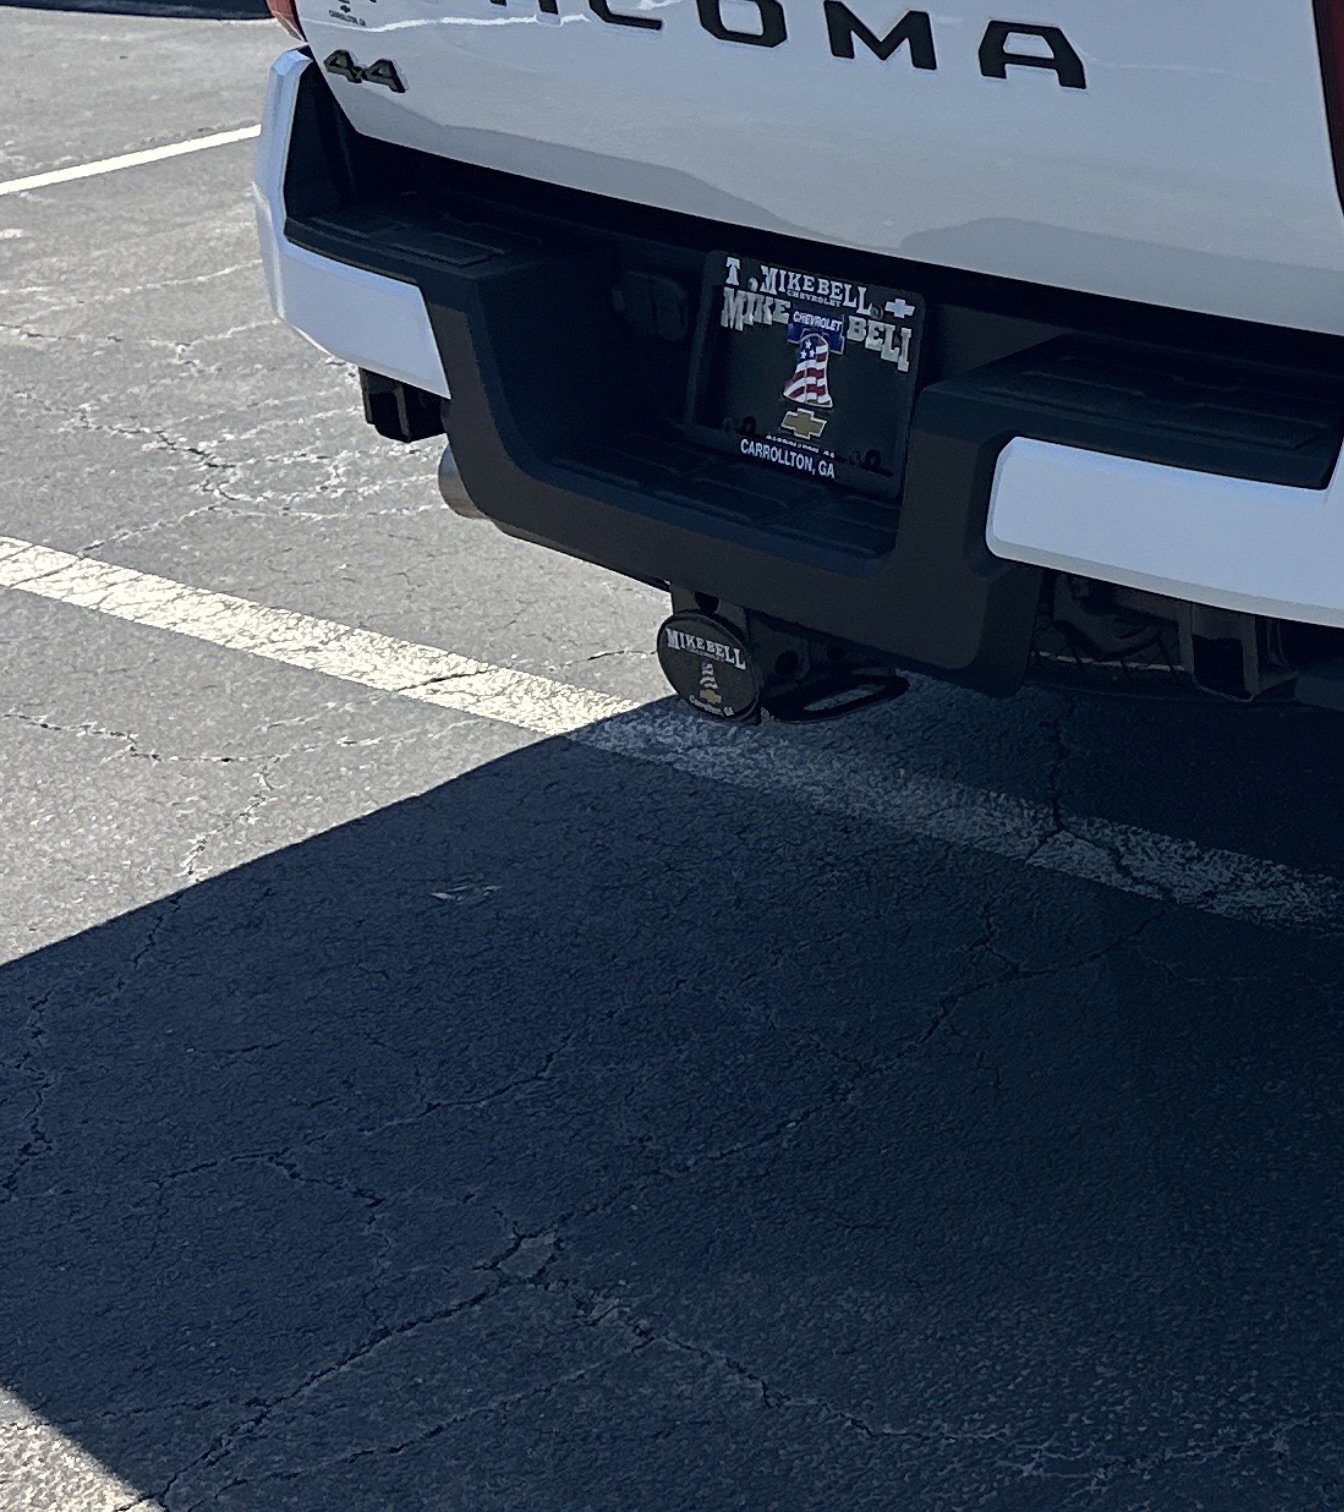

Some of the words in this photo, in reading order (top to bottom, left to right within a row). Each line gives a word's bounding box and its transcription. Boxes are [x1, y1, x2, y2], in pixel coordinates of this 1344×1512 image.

[720, 287, 791, 332] MIKE
[792, 310, 844, 333] CHEVROLET
[740, 438, 816, 475] CARROLLTON,
[817, 459, 836, 479] GA
